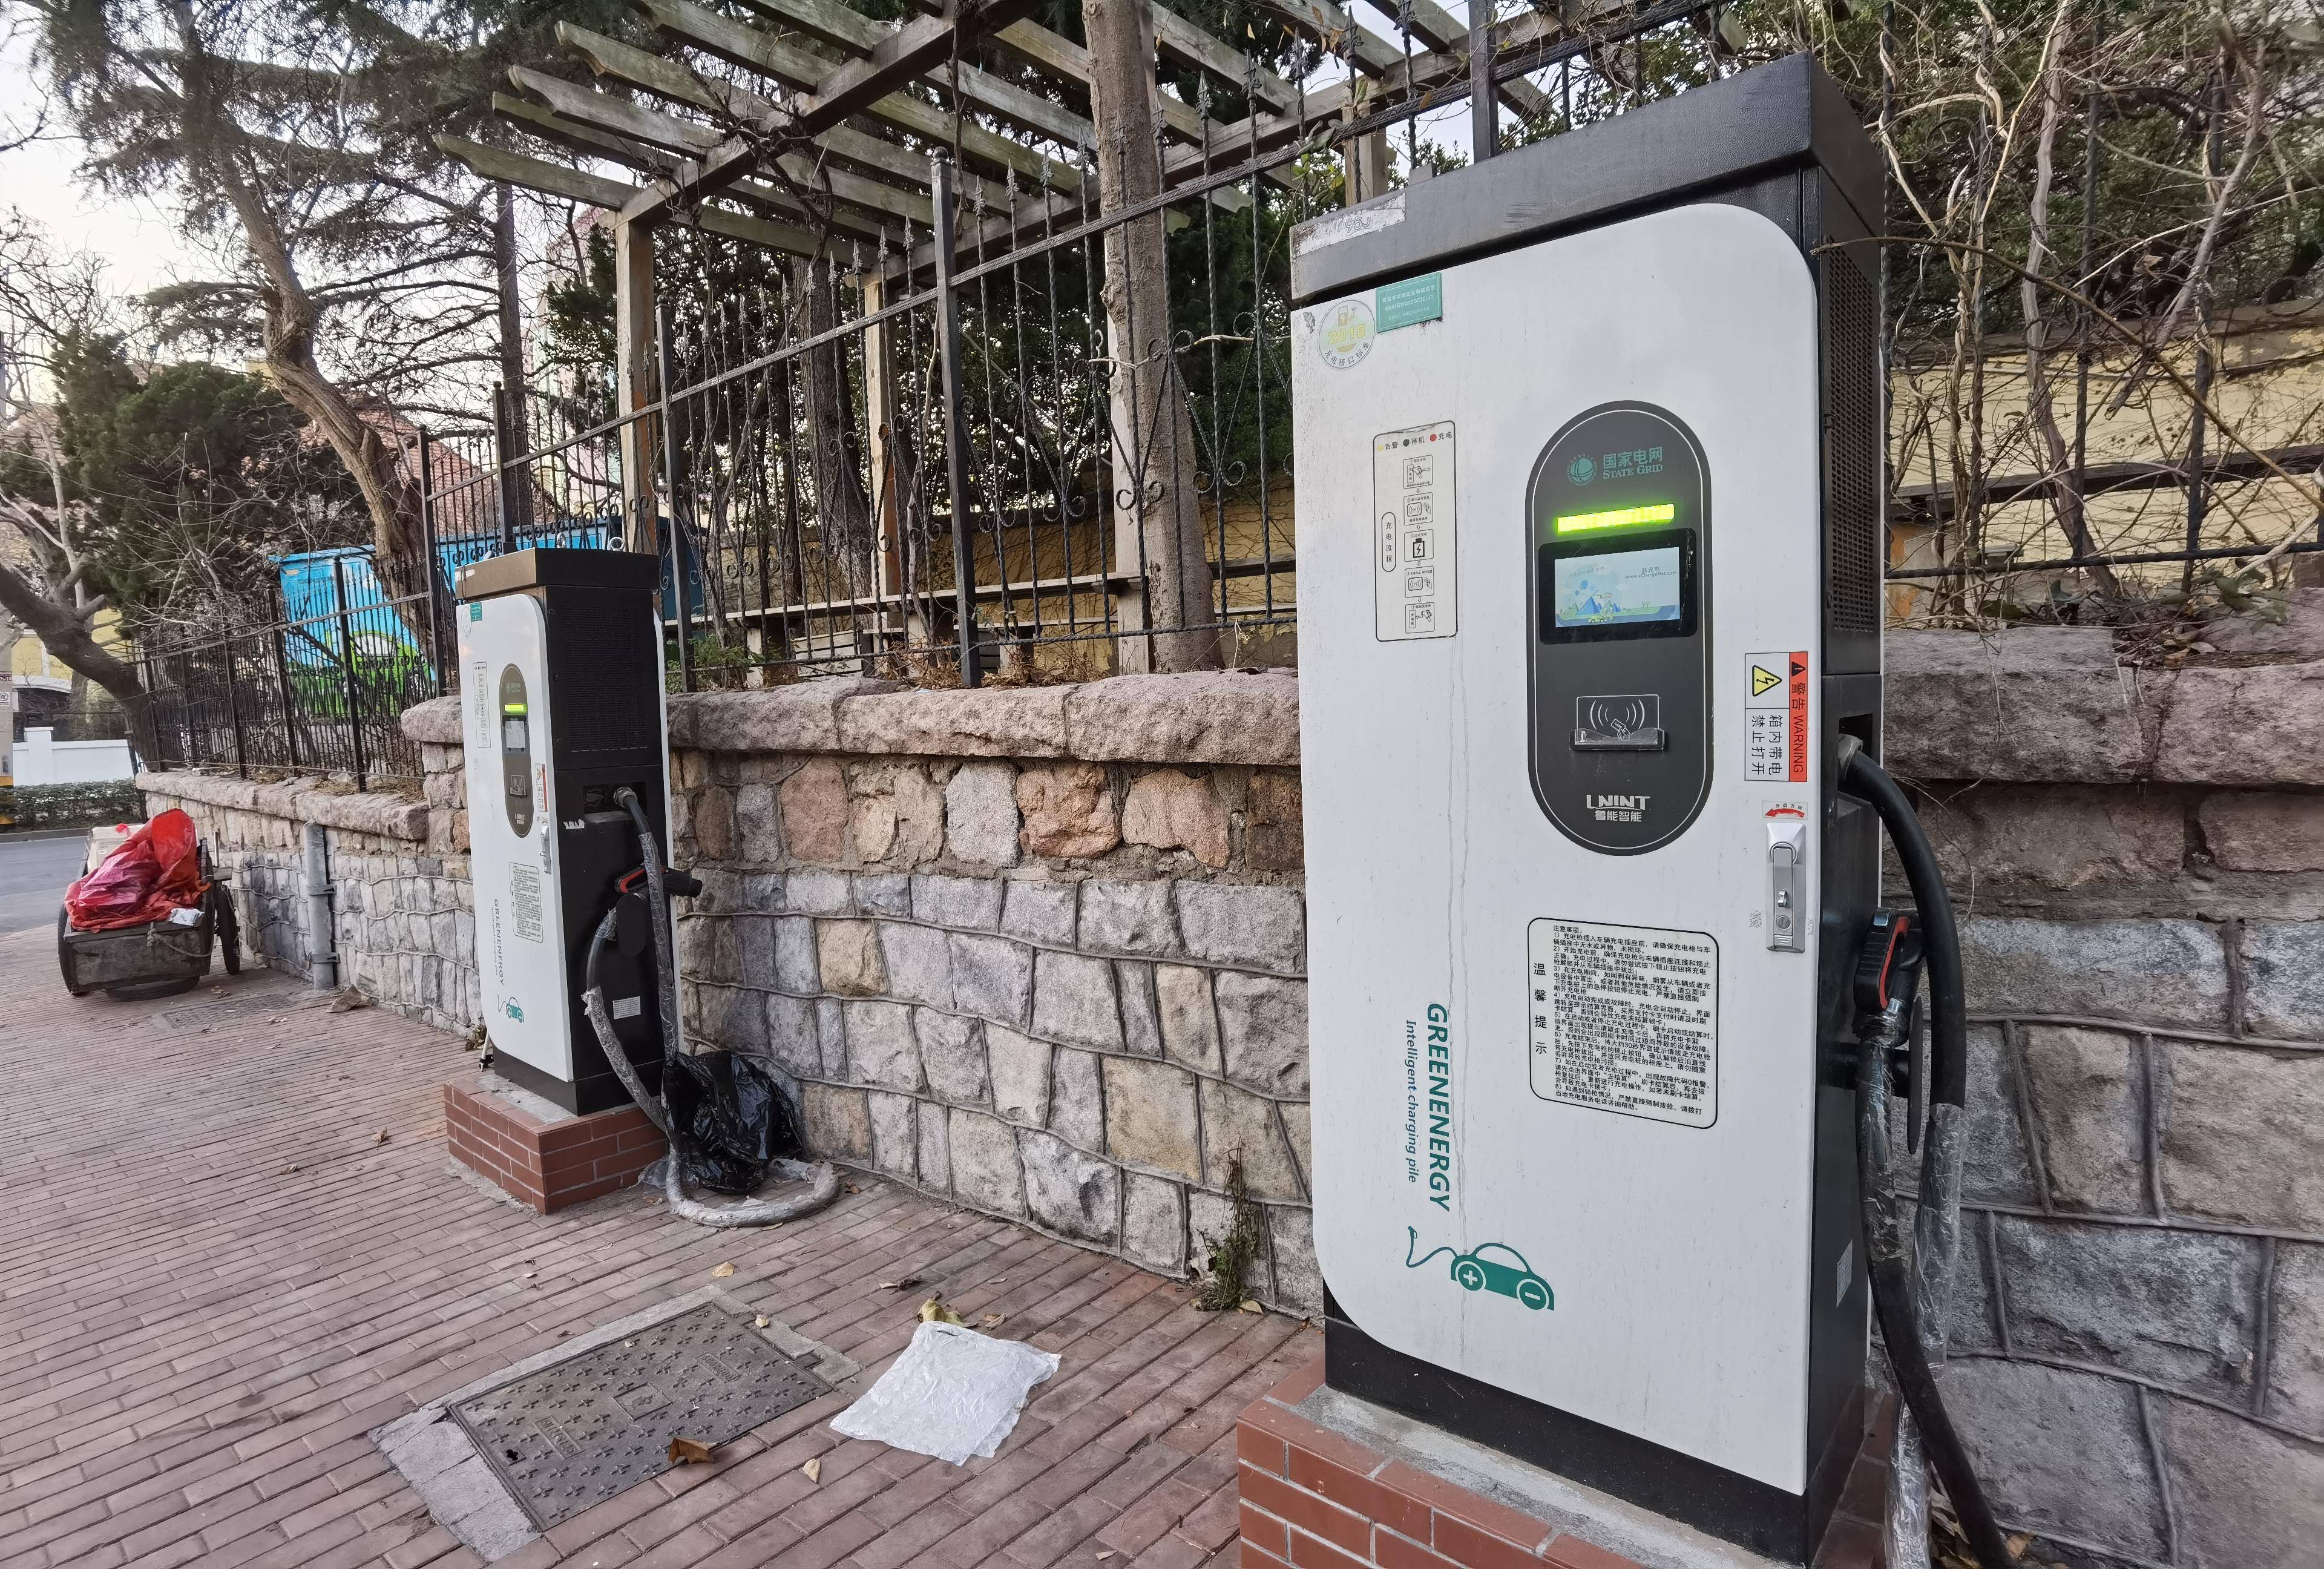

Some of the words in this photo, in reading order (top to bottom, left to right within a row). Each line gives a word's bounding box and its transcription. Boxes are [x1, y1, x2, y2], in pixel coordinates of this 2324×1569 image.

[1328, 323, 1366, 344] 2015
[1324, 341, 1370, 367] 充电接口标准
[1385, 441, 1399, 451] 告警
[1411, 436, 1425, 446] 待机
[1438, 431, 1452, 441] 充电
[1603, 446, 1663, 470] 国家电网
[1603, 467, 1634, 479] STATE
[1636, 464, 1663, 475] GRID
[1385, 521, 1393, 563] 充电流程
[1791, 682, 1806, 709] 警告
[1751, 715, 1765, 775] 禁止打开
[1768, 714, 1783, 775] 箱内带电
[1793, 714, 1804, 773] WARNING
[1586, 794, 1650, 810] LNINT
[1595, 810, 1643, 822] 鲁能智能
[494, 898, 504, 987] GREENENERGY
[1554, 985, 1587, 995] 断开充电枪
[1533, 962, 1548, 1055] 温馨提示
[1404, 1019, 1417, 1090] Intelligent
[1426, 1004, 1450, 1211] GREENENERGY
[1405, 1093, 1420, 1154] charging
[1406, 1159, 1419, 1183] pile
